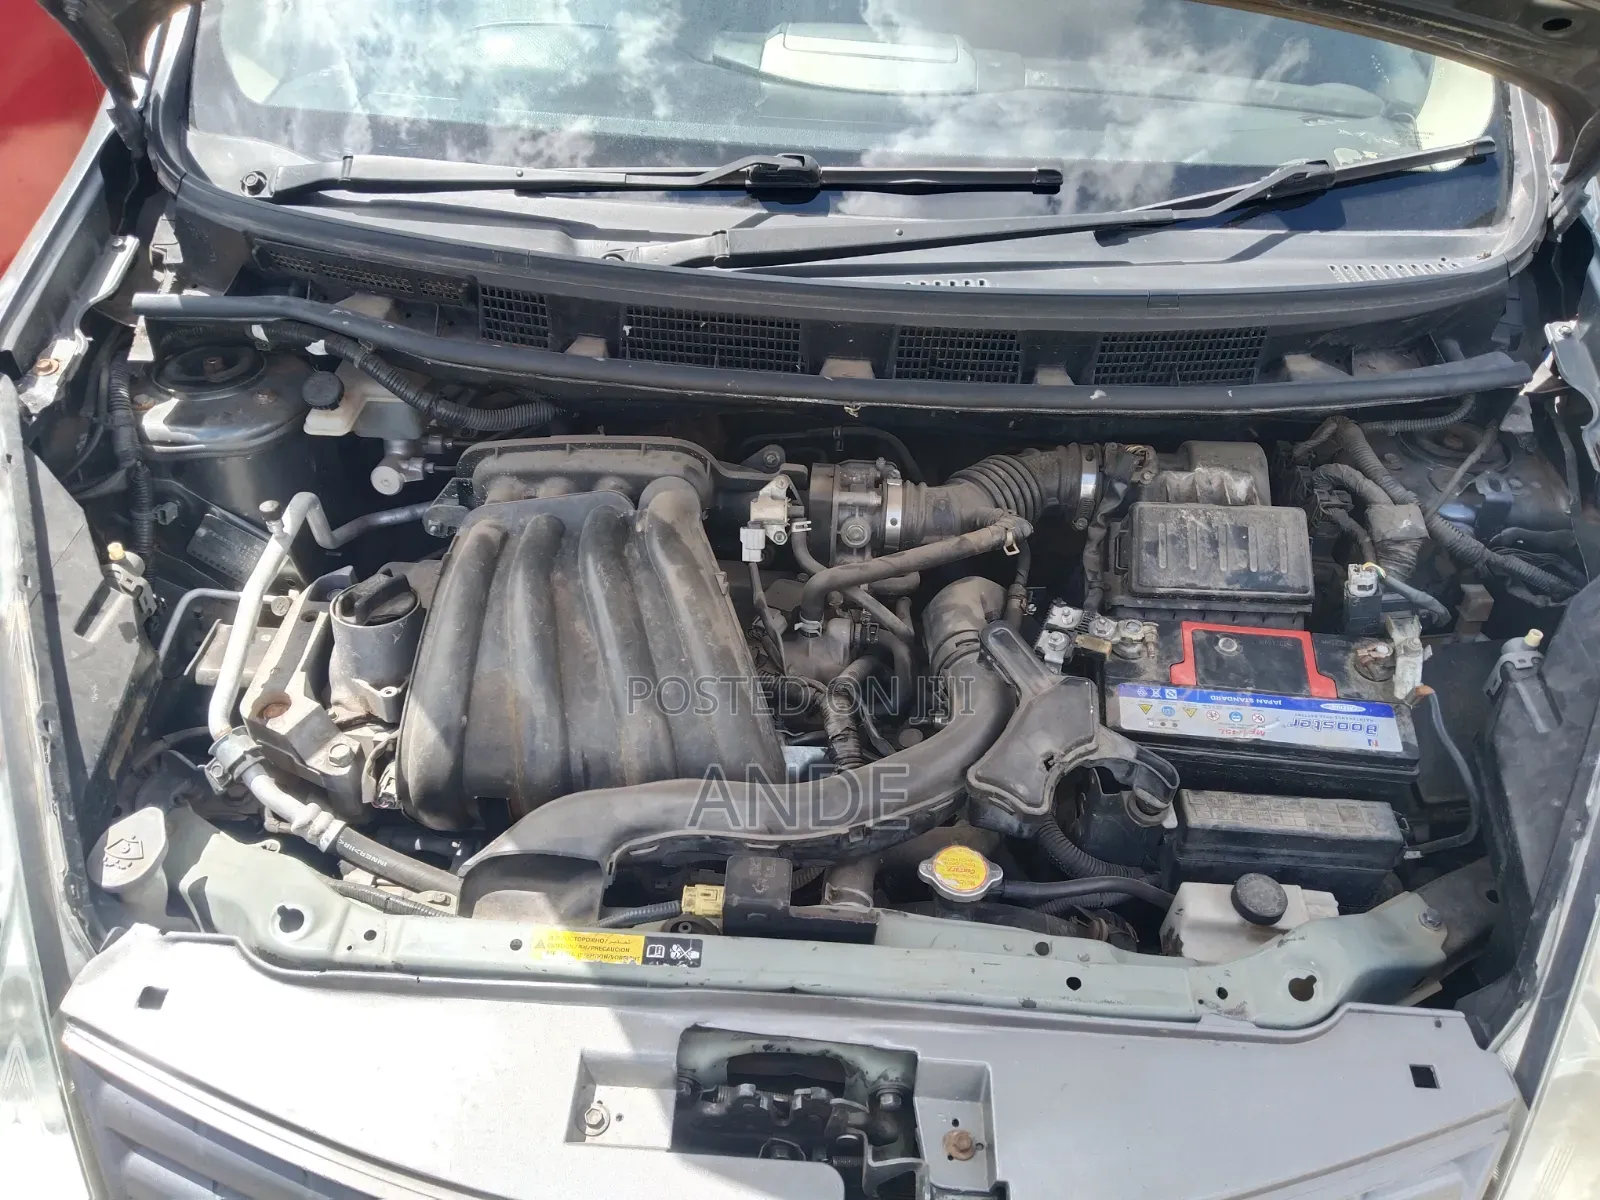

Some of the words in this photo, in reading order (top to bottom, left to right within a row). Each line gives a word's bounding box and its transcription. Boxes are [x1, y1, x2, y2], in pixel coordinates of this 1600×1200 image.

[1210, 694, 1255, 704] STANDARD
[1256, 697, 1282, 706] JAPAN
[1288, 718, 1379, 736] Booster
